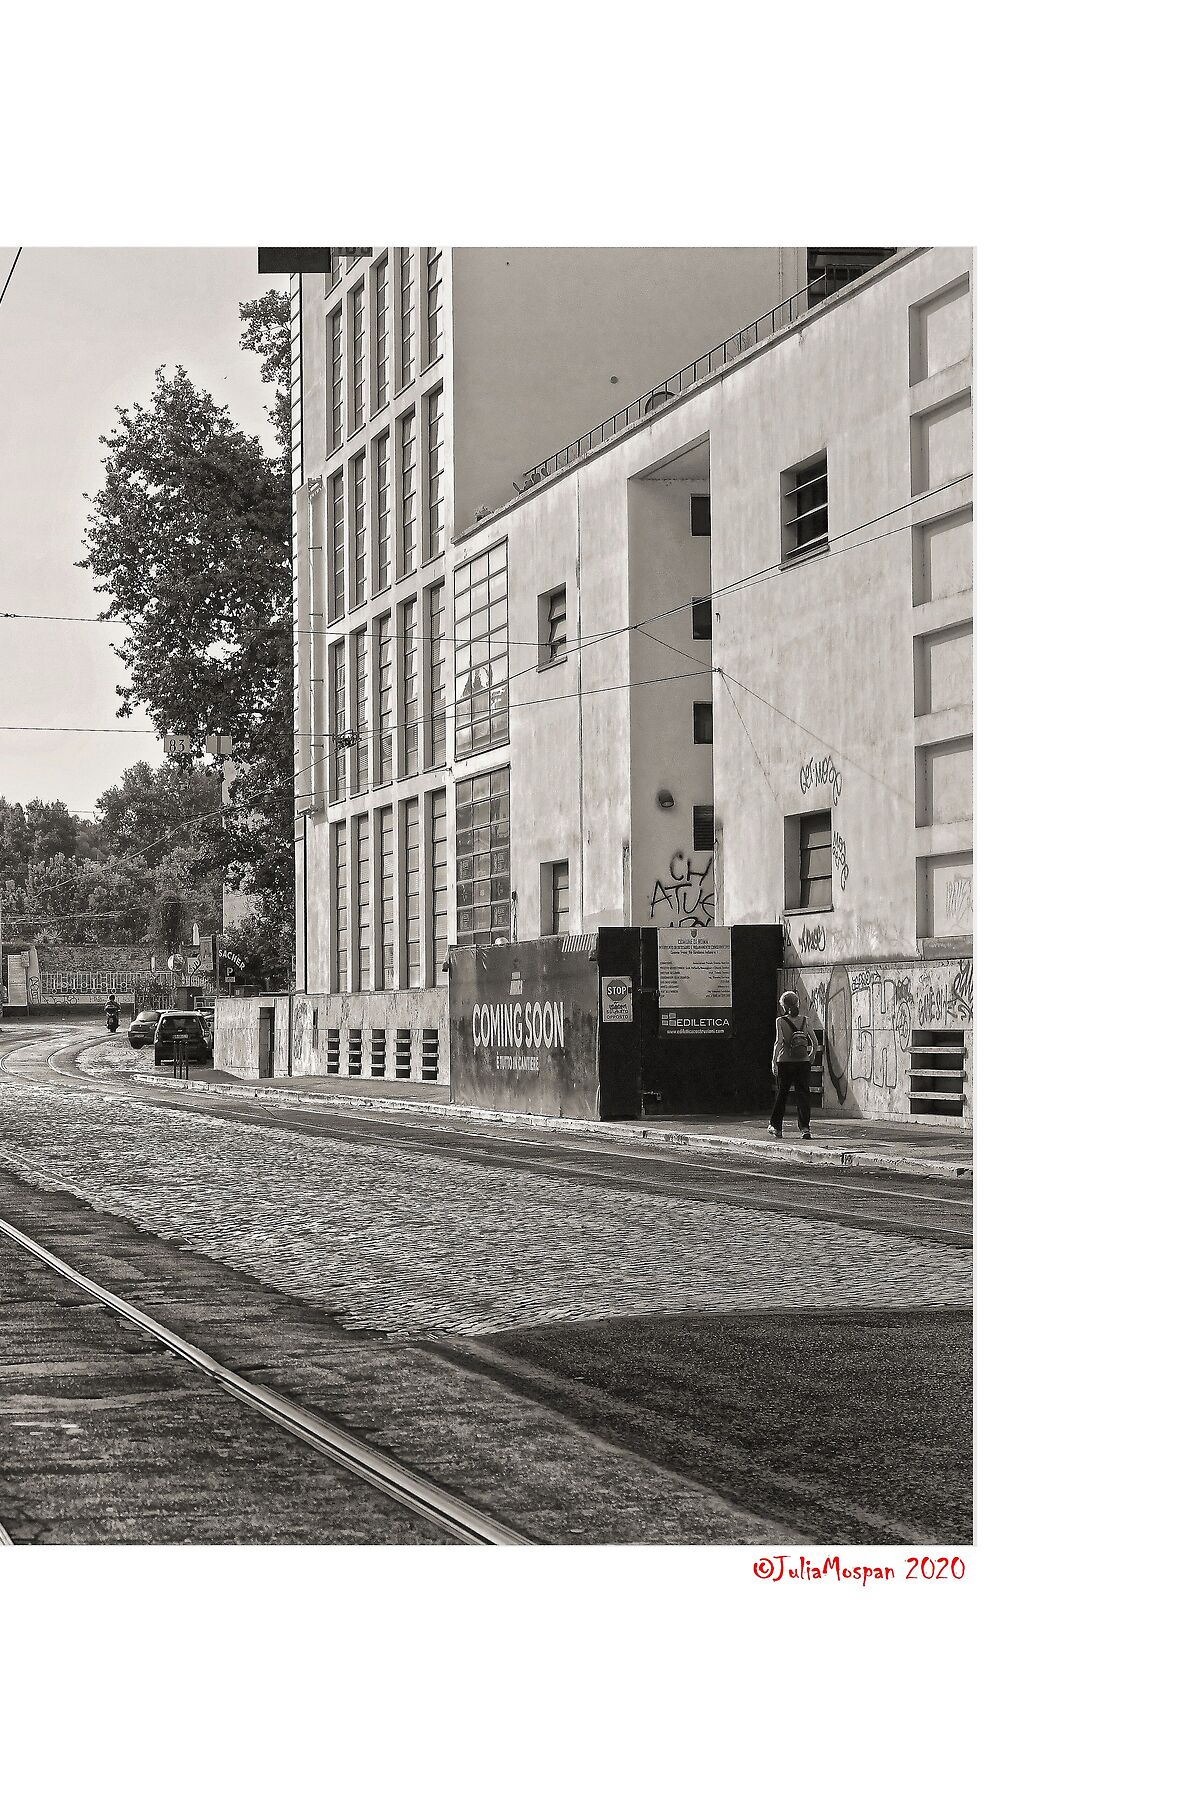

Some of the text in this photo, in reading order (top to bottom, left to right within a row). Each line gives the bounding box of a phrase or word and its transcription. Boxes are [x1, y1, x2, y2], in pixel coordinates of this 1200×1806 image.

[169, 739, 185, 752] 83
[218, 949, 246, 971] SACHER
[607, 986, 627, 995] STOP
[473, 1001, 564, 1048] COMING SOON
[676, 1018, 730, 1027] EDILETICA
